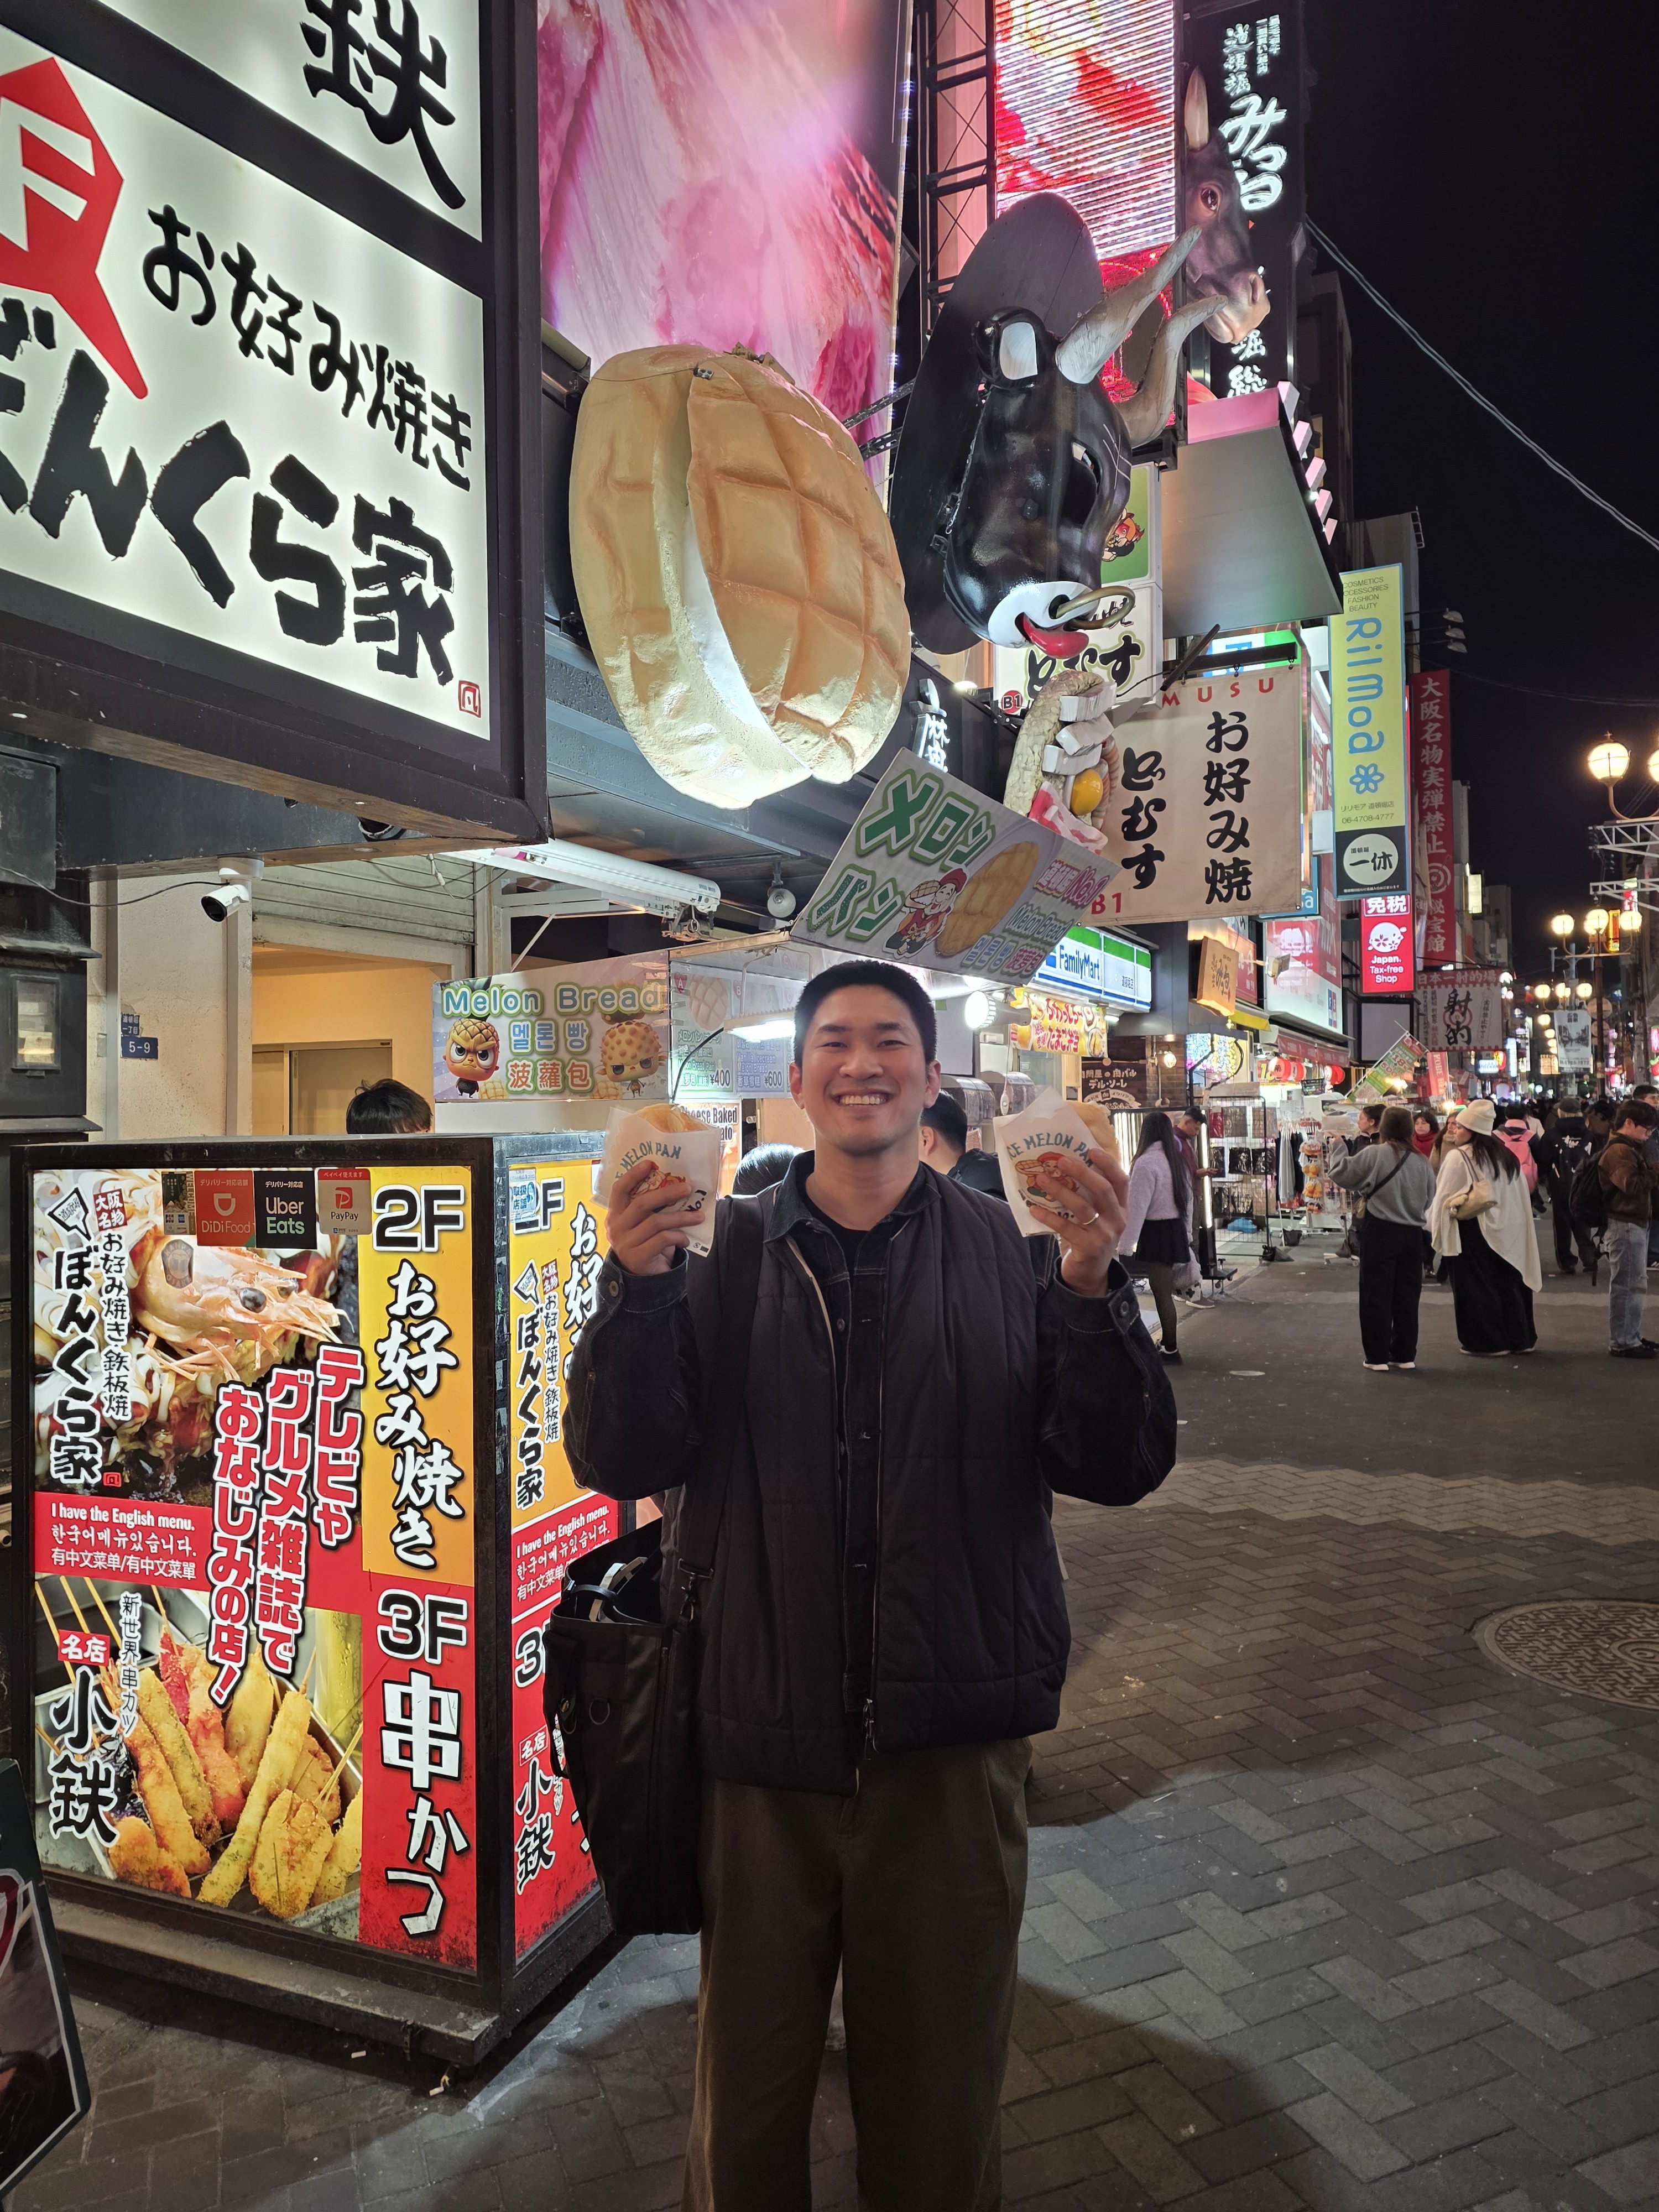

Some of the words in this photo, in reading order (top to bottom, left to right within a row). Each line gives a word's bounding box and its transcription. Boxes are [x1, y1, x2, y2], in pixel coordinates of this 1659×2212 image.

[143, 205, 471, 492] お好み焼き
[1344, 584, 1389, 596] CCESSORIES
[1348, 593, 1379, 604] FASHION
[1349, 602, 1377, 612] BEAUTY
[1346, 617, 1384, 754] Rilmoa
[1003, 695, 1021, 709] B1
[1420, 677, 1447, 854] 大阪名物実弾禁止
[1121, 747, 1166, 890] どむす
[1203, 711, 1252, 905] お好み焼
[1341, 804, 1366, 812] リリモア
[1368, 801, 1394, 810] 道頓堀店
[1342, 813, 1394, 824] 06-4708-4777
[860, 775, 994, 870] メロン
[1349, 852, 1393, 872] 一休
[1065, 868, 1109, 907] No.1
[811, 870, 904, 937] パン
[1092, 893, 1123, 915] B1
[1366, 895, 1407, 914] 免税
[1012, 905, 1043, 936] Melon
[1037, 914, 1069, 942] Bread
[1059, 945, 1100, 980] FamilyMart
[1370, 966, 1404, 974] Tax-free
[679, 979, 682, 988] A
[1375, 974, 1397, 984] Shop
[1418, 972, 1496, 984] 日本一射的場
[445, 988, 540, 1015] Melon
[557, 985, 666, 1012] Bread
[122, 1026, 138, 1035] 一丁目
[1444, 989, 1473, 1046] 射的
[129, 1041, 150, 1053] 5-9
[510, 1020, 557, 1052] 멜론
[565, 1020, 588, 1051] 빵
[1047, 1025, 1079, 1052] たまご弁当
[737, 1054, 757, 1063] Vanilla
[737, 1062, 753, 1072] Melon
[508, 1059, 592, 1092] 菠蘿包
[710, 1070, 730, 1087] ¥400
[764, 1071, 782, 1087] ¥600
[713, 1107, 737, 1123] Baked
[1024, 1132, 1074, 1150] MELON
[620, 1141, 653, 1171] MELON
[655, 1142, 681, 1159] PAN
[95, 1191, 123, 1211] 大阪
[265, 1197, 304, 1214] Uber
[98, 1209, 125, 1229] 名物
[202, 1220, 224, 1233] DiDi
[226, 1220, 251, 1233] Food
[266, 1217, 305, 1234] Eats
[331, 1212, 358, 1221] PayPay
[375, 1188, 463, 1251] 2F
[53, 1245, 101, 1483] ぼんくら家
[377, 1262, 465, 1567] お好み焼き
[517, 1310, 541, 1508] ぼんくら家
[314, 1347, 363, 1545] テレビや
[52, 1503, 56, 1517] I
[59, 1502, 87, 1520] have
[90, 1505, 109, 1522] the
[112, 1508, 155, 1528] English
[158, 1515, 195, 1531] menu.
[254, 1368, 311, 1674] グルメ雑誌で
[208, 1386, 260, 1704] おなじみの店!
[517, 1545, 520, 1558] I
[522, 1539, 542, 1555] have
[543, 1530, 556, 1545] the
[558, 1513, 585, 1537] English
[587, 1505, 609, 1522] menu.
[380, 1592, 467, 1662] 3F
[61, 1633, 106, 1663] 名店
[121, 1592, 142, 1735] 新世界串カツ
[50, 1671, 118, 1844] 小鉄
[521, 1731, 545, 1759] 名店
[383, 1673, 469, 1938] 串かつ
